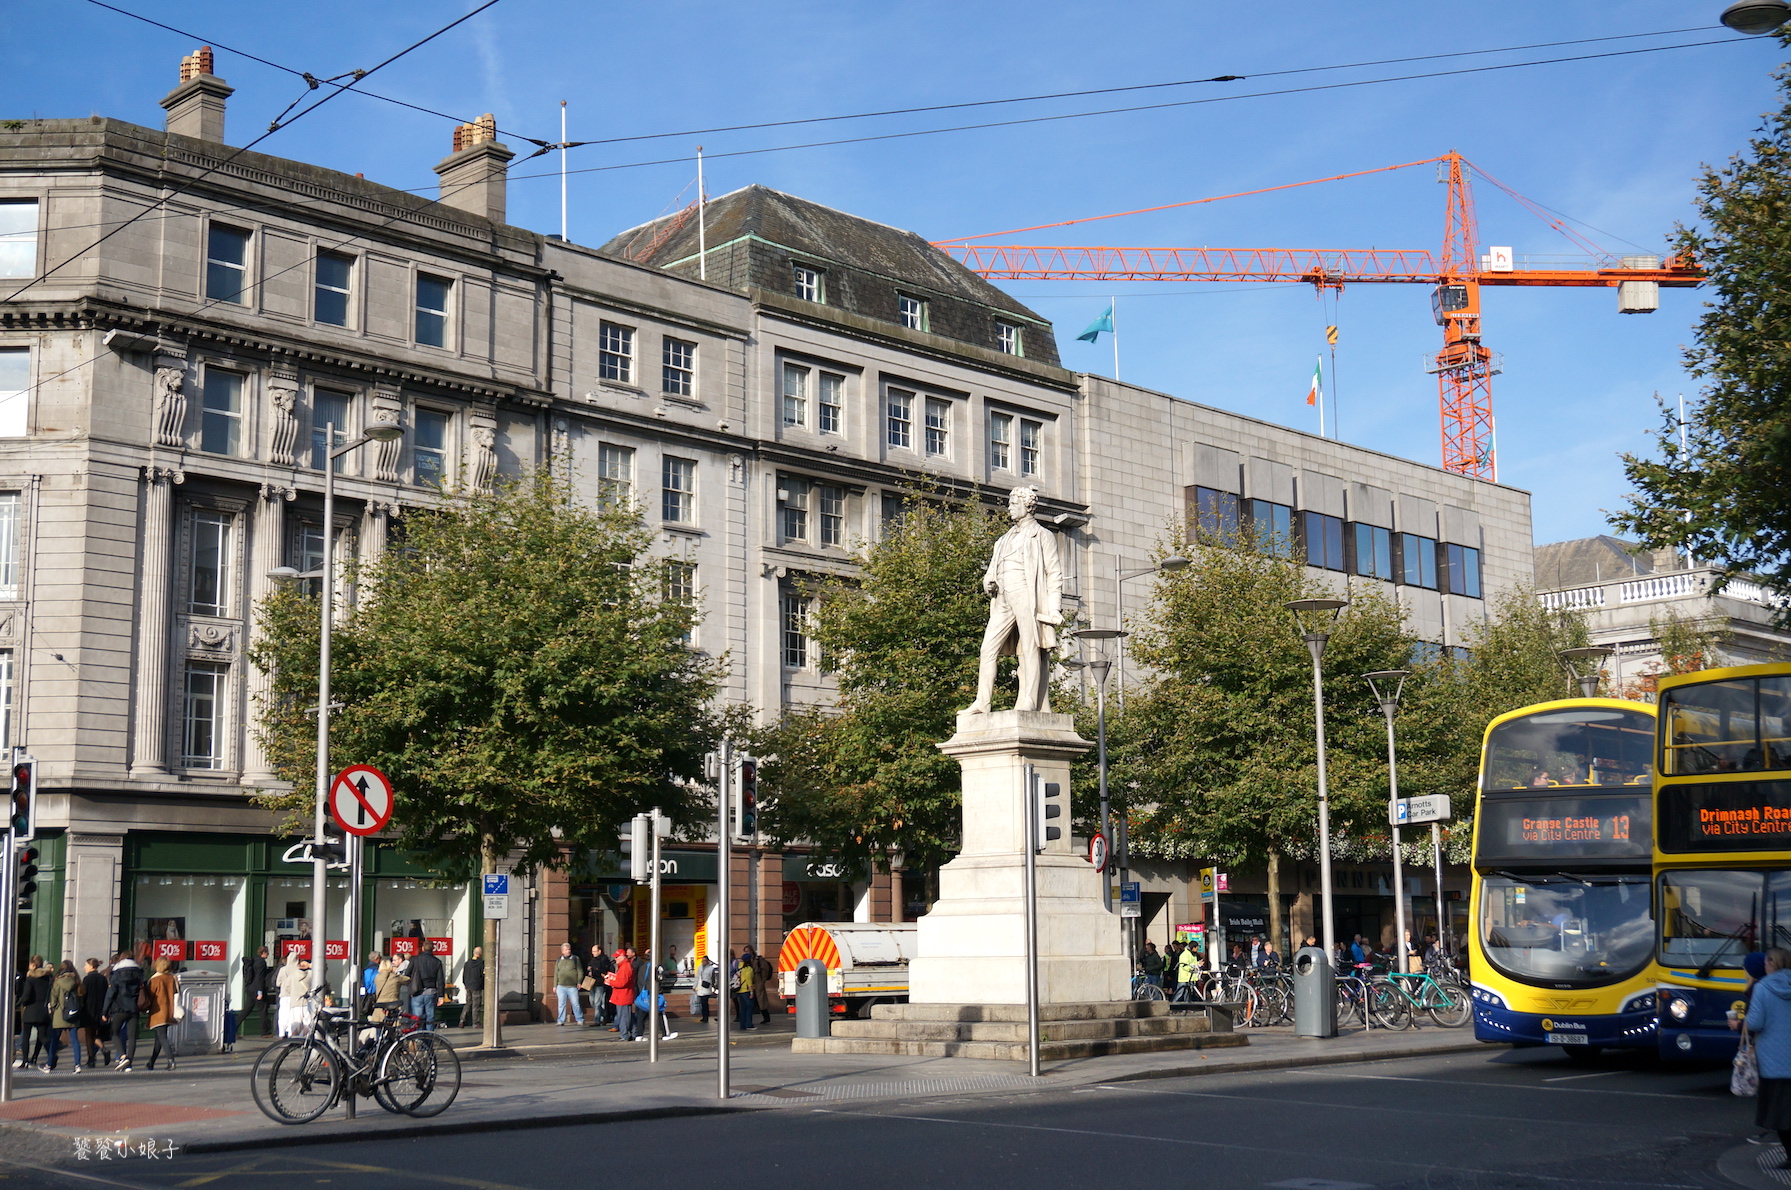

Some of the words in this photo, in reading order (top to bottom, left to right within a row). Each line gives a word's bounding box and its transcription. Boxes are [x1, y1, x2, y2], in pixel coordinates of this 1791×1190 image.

[1407, 801, 1432, 809] Arnotts
[1700, 807, 1760, 822] Drimnagh
[1523, 818, 1561, 830] Grange
[1564, 817, 1599, 828] Castle
[1612, 816, 1629, 839] 13
[1701, 822, 1720, 835] via
[1723, 821, 1749, 834] City
[1522, 830, 1538, 840] via
[1541, 830, 1562, 840] City
[1564, 829, 1600, 840] Centre
[1096, 841, 1103, 857] 30
[161, 944, 180, 956] 50%
[202, 945, 220, 956] 50%
[326, 944, 343, 955] 50%
[396, 941, 413, 952] 50%
[1554, 1021, 1573, 1029] Dublin
